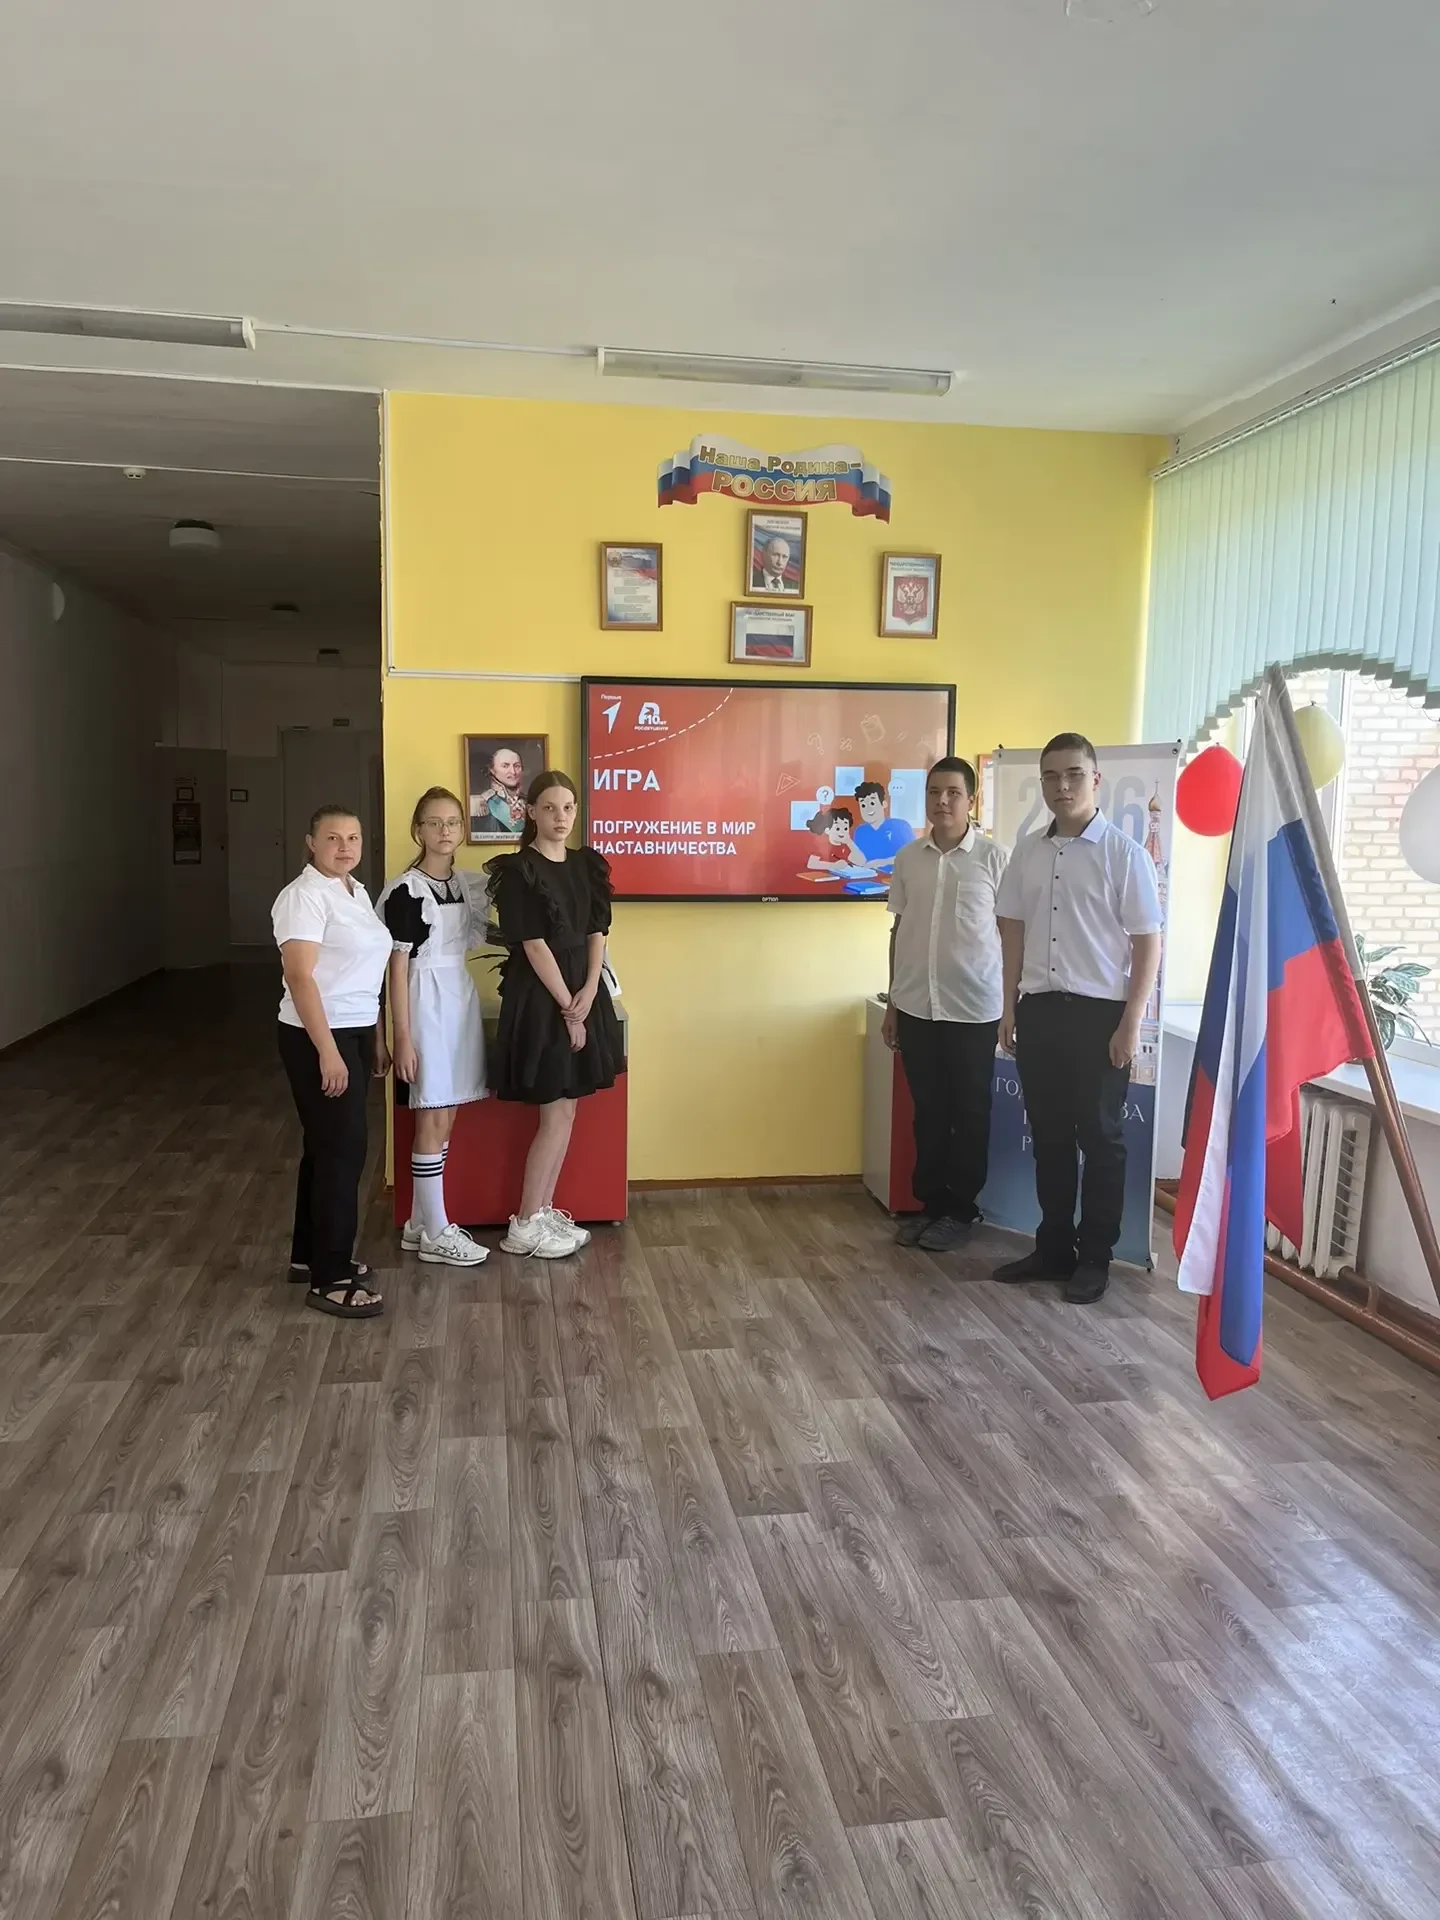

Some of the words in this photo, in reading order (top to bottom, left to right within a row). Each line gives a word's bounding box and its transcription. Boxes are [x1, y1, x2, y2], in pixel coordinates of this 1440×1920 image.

[699, 445, 761, 471] Наша
[712, 469, 837, 501] РОССИЯ
[646, 714, 660, 725] 10
[593, 769, 660, 791] ИГРА
[592, 820, 702, 834] ПОГРУЖЕНИЕ
[707, 822, 717, 834] В
[722, 821, 756, 834] МИР
[593, 841, 737, 855] НАСТАВНИЧЕСТВА
